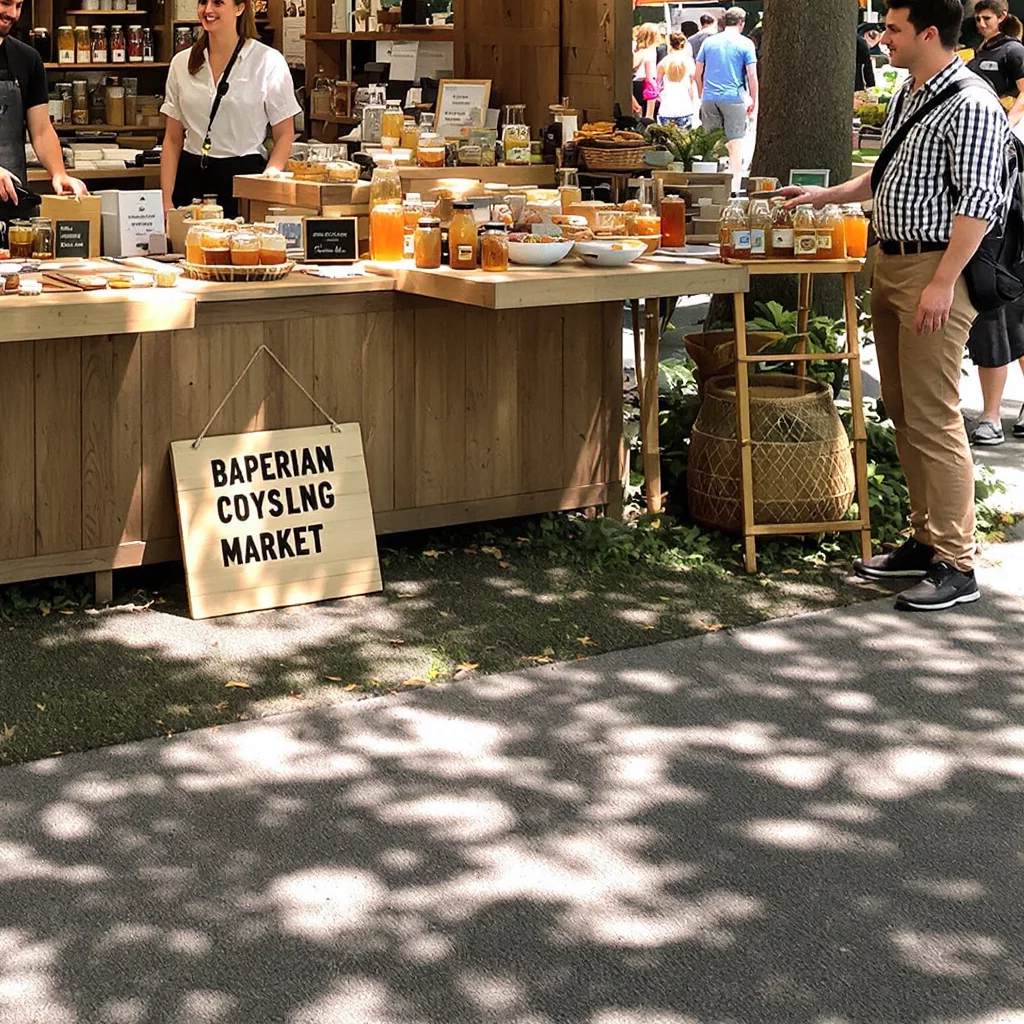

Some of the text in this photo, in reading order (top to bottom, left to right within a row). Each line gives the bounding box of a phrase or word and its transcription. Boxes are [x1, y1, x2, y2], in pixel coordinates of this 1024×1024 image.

[211, 445, 334, 488] BAPERIAN
[217, 481, 335, 524] COYSLNG
[220, 524, 323, 567] MARKET
